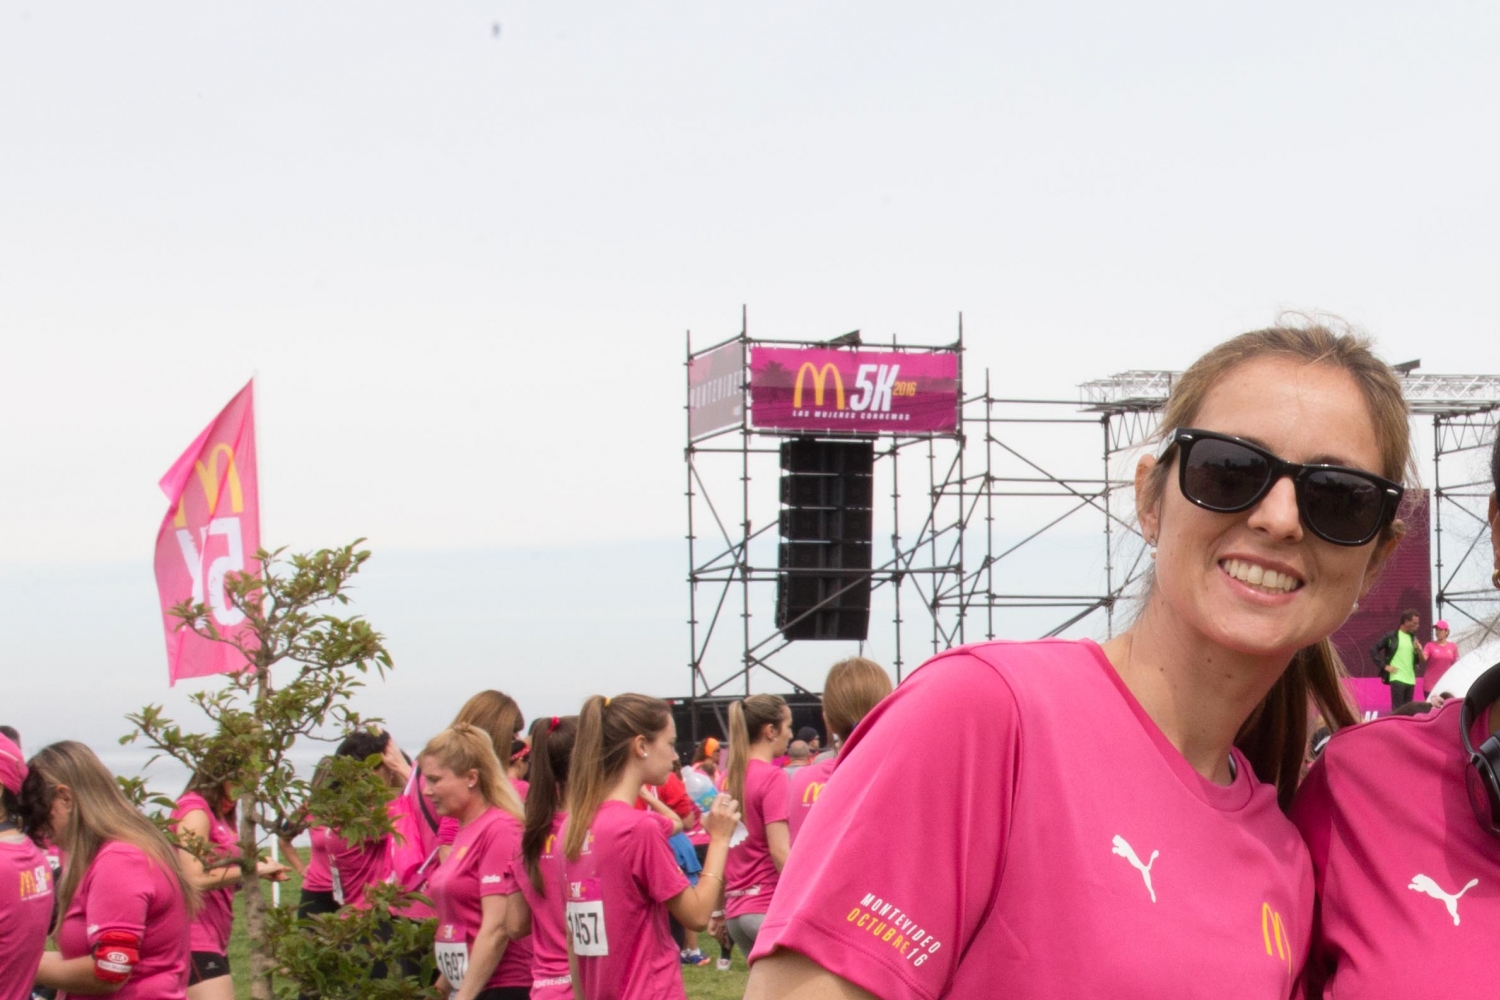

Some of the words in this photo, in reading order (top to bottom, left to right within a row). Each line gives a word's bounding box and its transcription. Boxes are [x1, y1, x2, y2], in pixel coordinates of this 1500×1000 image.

[850, 364, 899, 412] 5K
[893, 381, 916, 396] 2016
[814, 411, 856, 419] MUJERES
[860, 412, 910, 420] CORREMOS
[847, 908, 910, 954] OCTUBRE
[906, 948, 928, 967] 16
[860, 893, 941, 953] MONTEVIDEO
